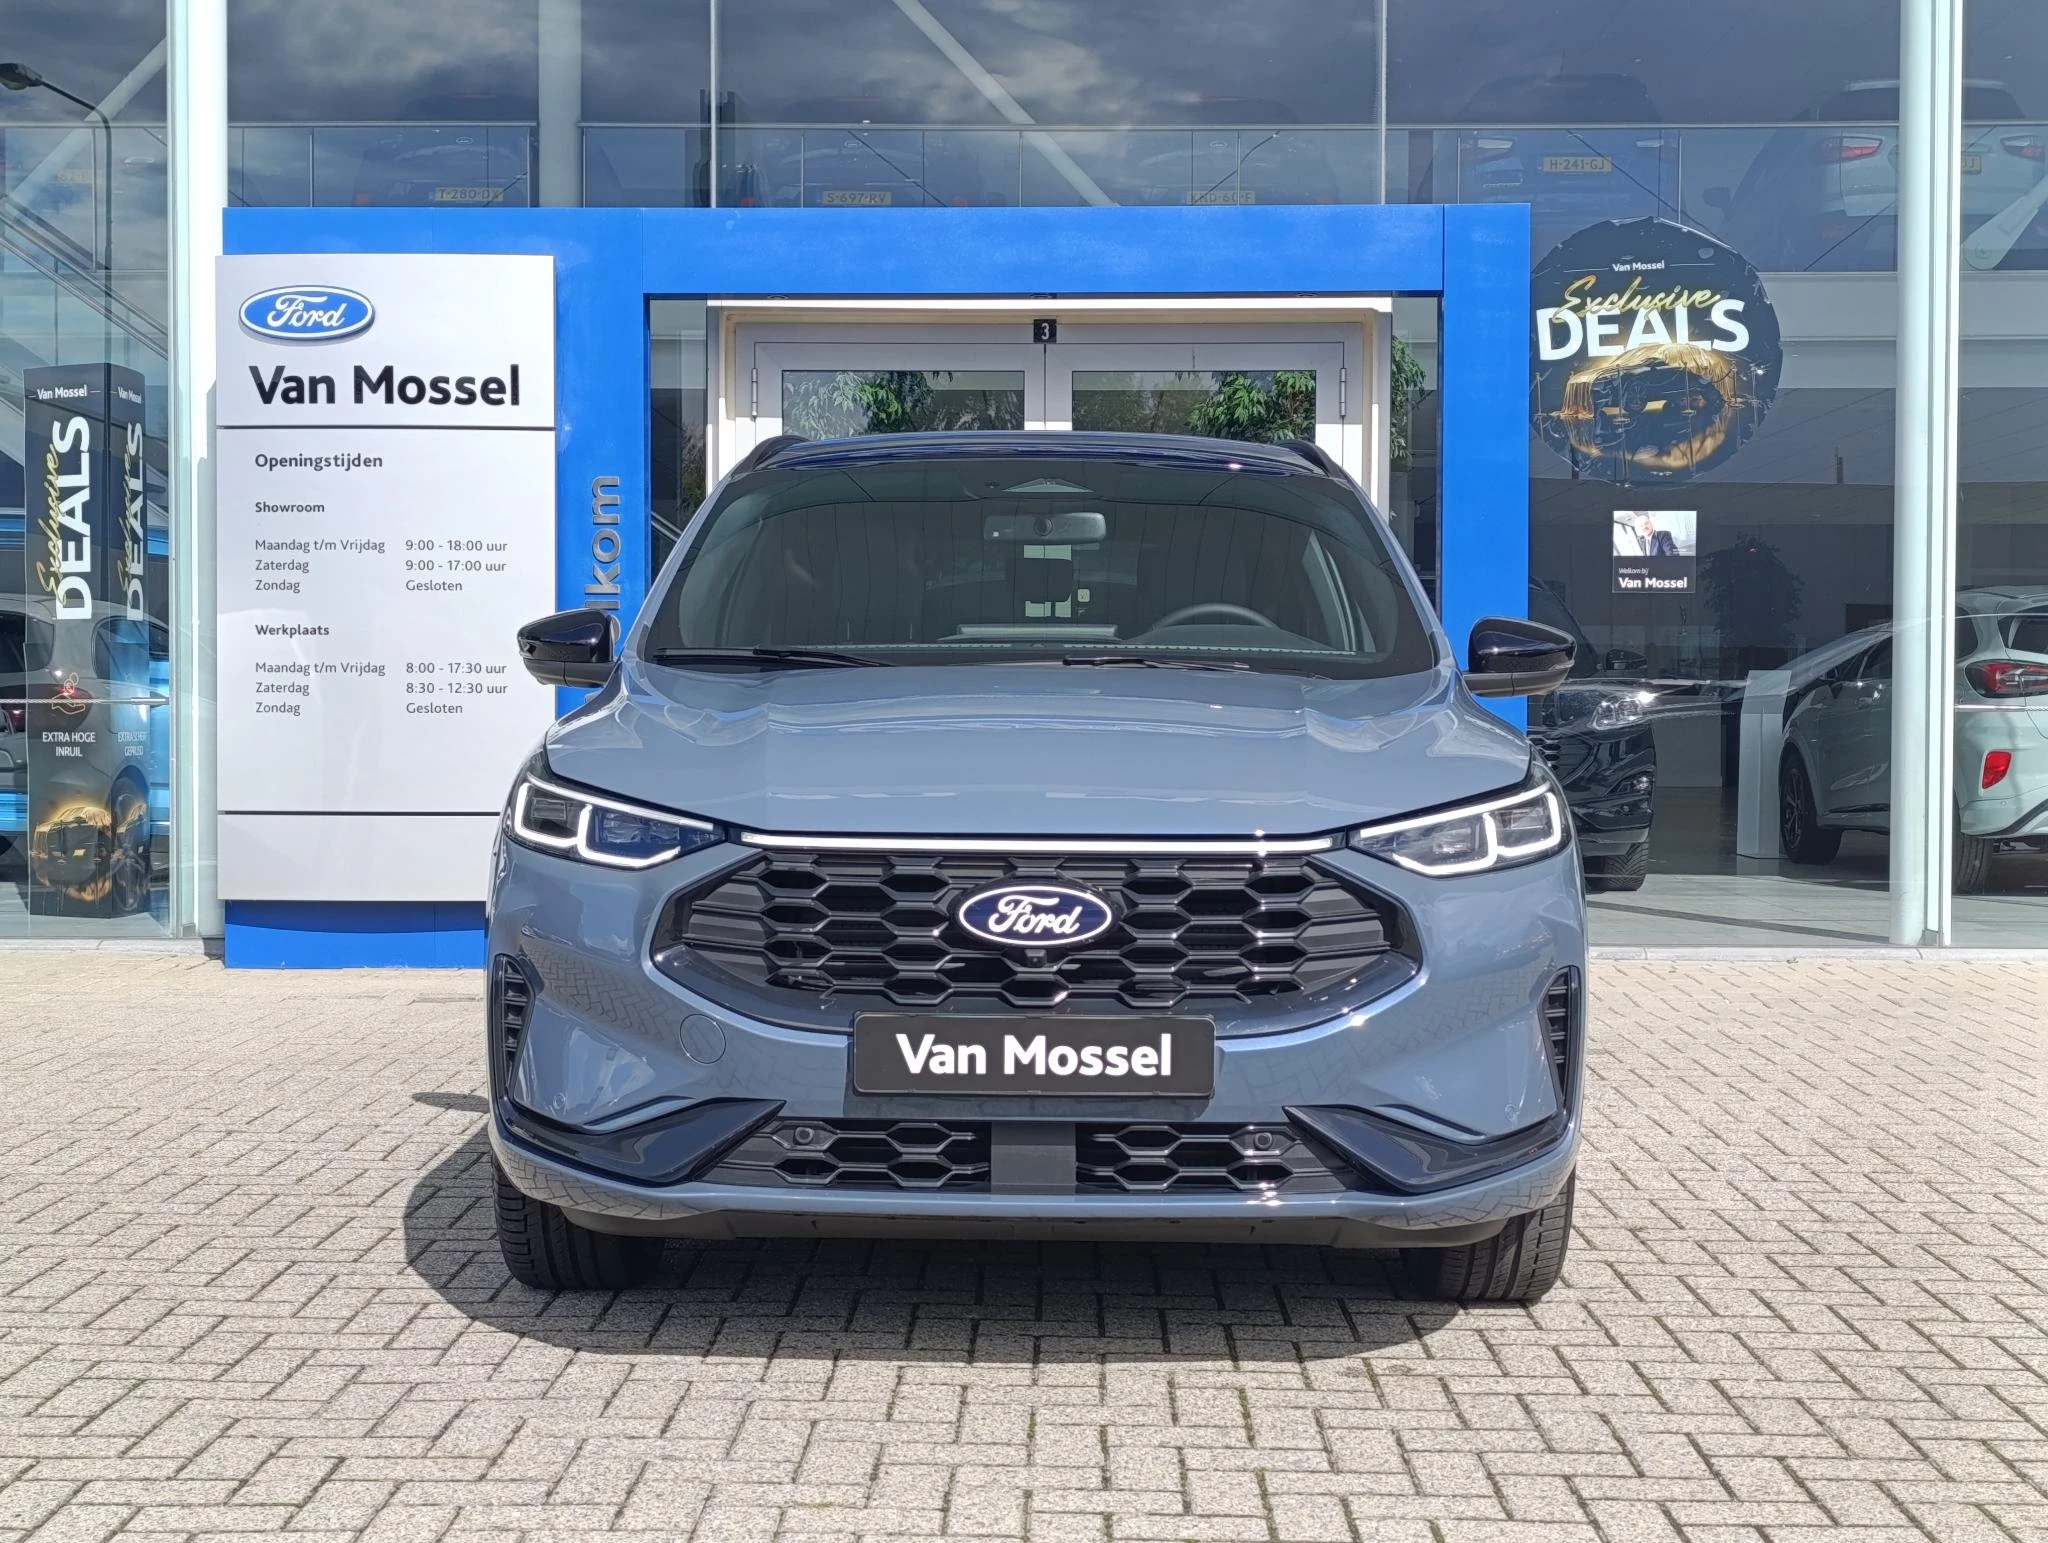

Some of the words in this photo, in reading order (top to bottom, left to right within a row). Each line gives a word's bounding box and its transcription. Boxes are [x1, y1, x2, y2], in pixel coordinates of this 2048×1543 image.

[1612, 263, 1630, 271] Van
[1633, 260, 1665, 270] Mossel
[1552, 275, 1721, 324] Exclusive
[267, 294, 349, 327] Ford
[1041, 322, 1050, 340] 3
[1536, 299, 1749, 361] DEALS
[249, 366, 335, 404] Van
[354, 364, 519, 405] Mossel
[37, 389, 53, 400] Van
[55, 384, 87, 398] Mossel
[118, 386, 128, 400] Van
[255, 453, 382, 471] Openingstijden
[256, 502, 324, 512] Showroom
[52, 416, 92, 620] DEALS
[126, 422, 143, 621] DEALS
[256, 539, 310, 553] Maandag
[314, 539, 336, 550] t/m
[341, 539, 385, 553] Vrijdag
[406, 540, 434, 550] 9:00
[448, 540, 482, 551] 18:00
[256, 560, 309, 573] Zaterdag
[406, 560, 434, 570] 9:00
[448, 560, 481, 571] 17:00
[256, 579, 300, 593] Zondag
[406, 580, 462, 590] Gesloten
[1619, 577, 1641, 588] Van
[1645, 577, 1687, 588] Mossel
[255, 624, 329, 638] Werkplaats
[256, 662, 310, 676] Maandag
[315, 662, 336, 673] t/m
[341, 662, 385, 676] Vrijdag
[407, 663, 434, 673] 8:00
[448, 663, 481, 673] 17:30
[256, 682, 309, 696] Zaterdag
[406, 683, 434, 693] 8:30
[448, 683, 482, 693] 12:30
[256, 702, 300, 716] Zondag
[407, 702, 462, 713] Gesloten
[42, 732, 70, 742] EXTRA
[72, 732, 96, 742] HOGE
[56, 746, 83, 757] INRUIL
[988, 895, 1082, 934] Ford
[896, 1034, 986, 1074] Van
[1004, 1034, 1171, 1076] Mossel
